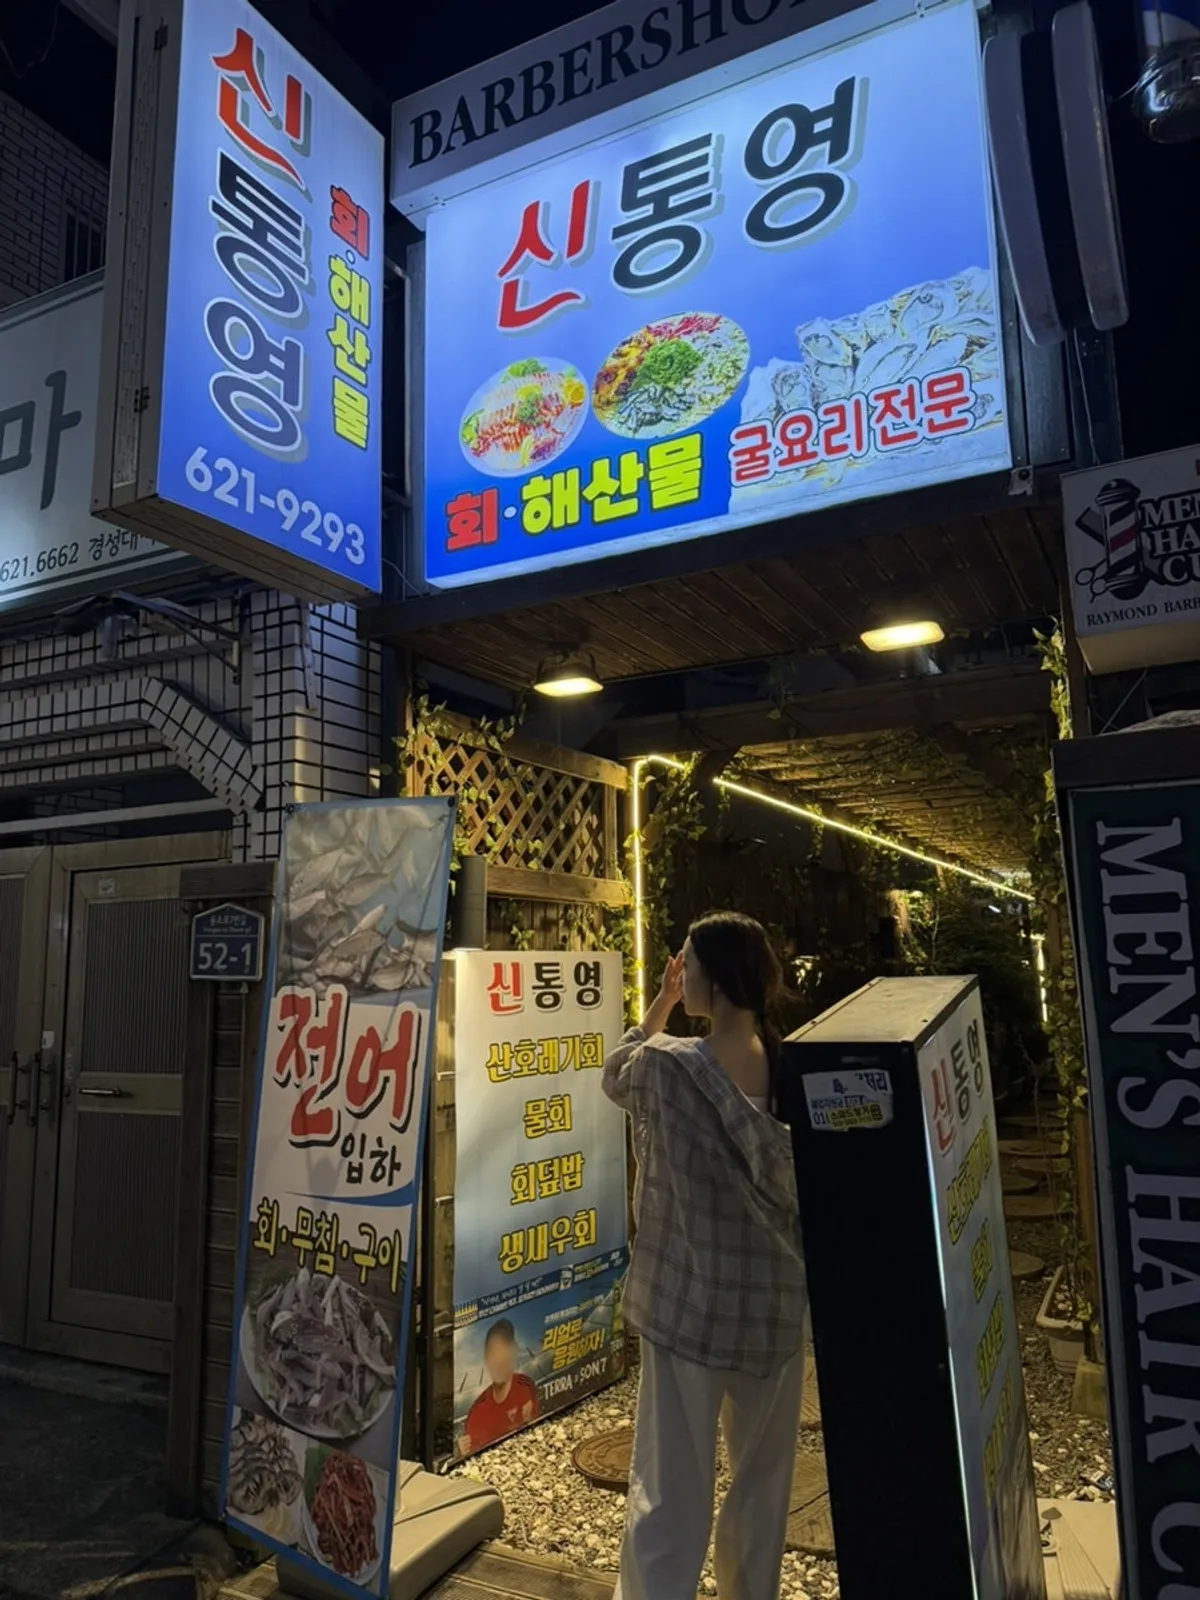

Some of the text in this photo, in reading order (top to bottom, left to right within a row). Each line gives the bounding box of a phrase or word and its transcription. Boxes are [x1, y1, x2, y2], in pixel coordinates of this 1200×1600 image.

[408, 0, 818, 169] BARBERSHO
[496, 76, 862, 332] 신통영
[207, 27, 305, 452] 신통영
[728, 368, 976, 485] 굴요리전문
[185, 446, 366, 566] 621-9293
[1087, 603, 1158, 627] RAYMOND
[197, 942, 253, 971] 52-1
[486, 960, 604, 1014] 신통영
[274, 990, 418, 1142] 전어
[930, 1018, 983, 1154] 신통영
[523, 1094, 573, 1139] 물회
[340, 1131, 403, 1188] 입하
[509, 1151, 586, 1206] 회덮밥
[498, 1208, 598, 1274] 생새우회
[541, 1317, 584, 1351] 리얼로
[543, 1374, 574, 1400] TERRA
